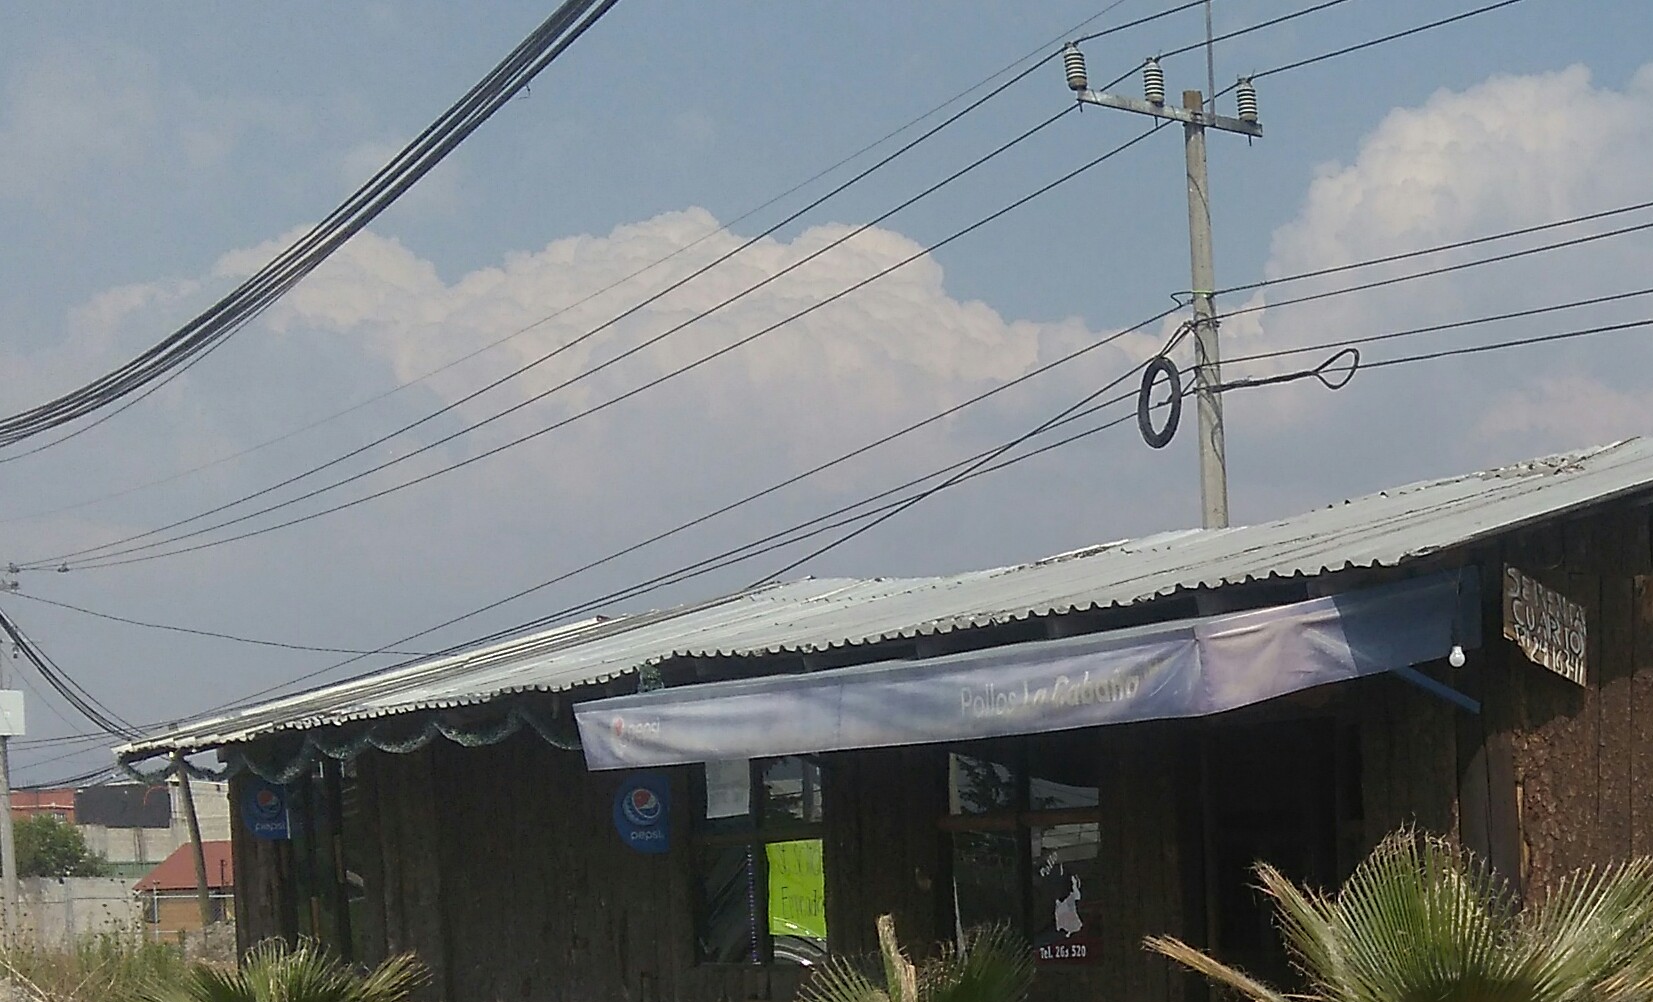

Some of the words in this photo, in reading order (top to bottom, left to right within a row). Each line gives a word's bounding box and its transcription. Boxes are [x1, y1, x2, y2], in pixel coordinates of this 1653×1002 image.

[1512, 598, 1585, 659] CUARTO
[960, 683, 1017, 720] Pollos
[630, 829, 663, 841] pepsi
